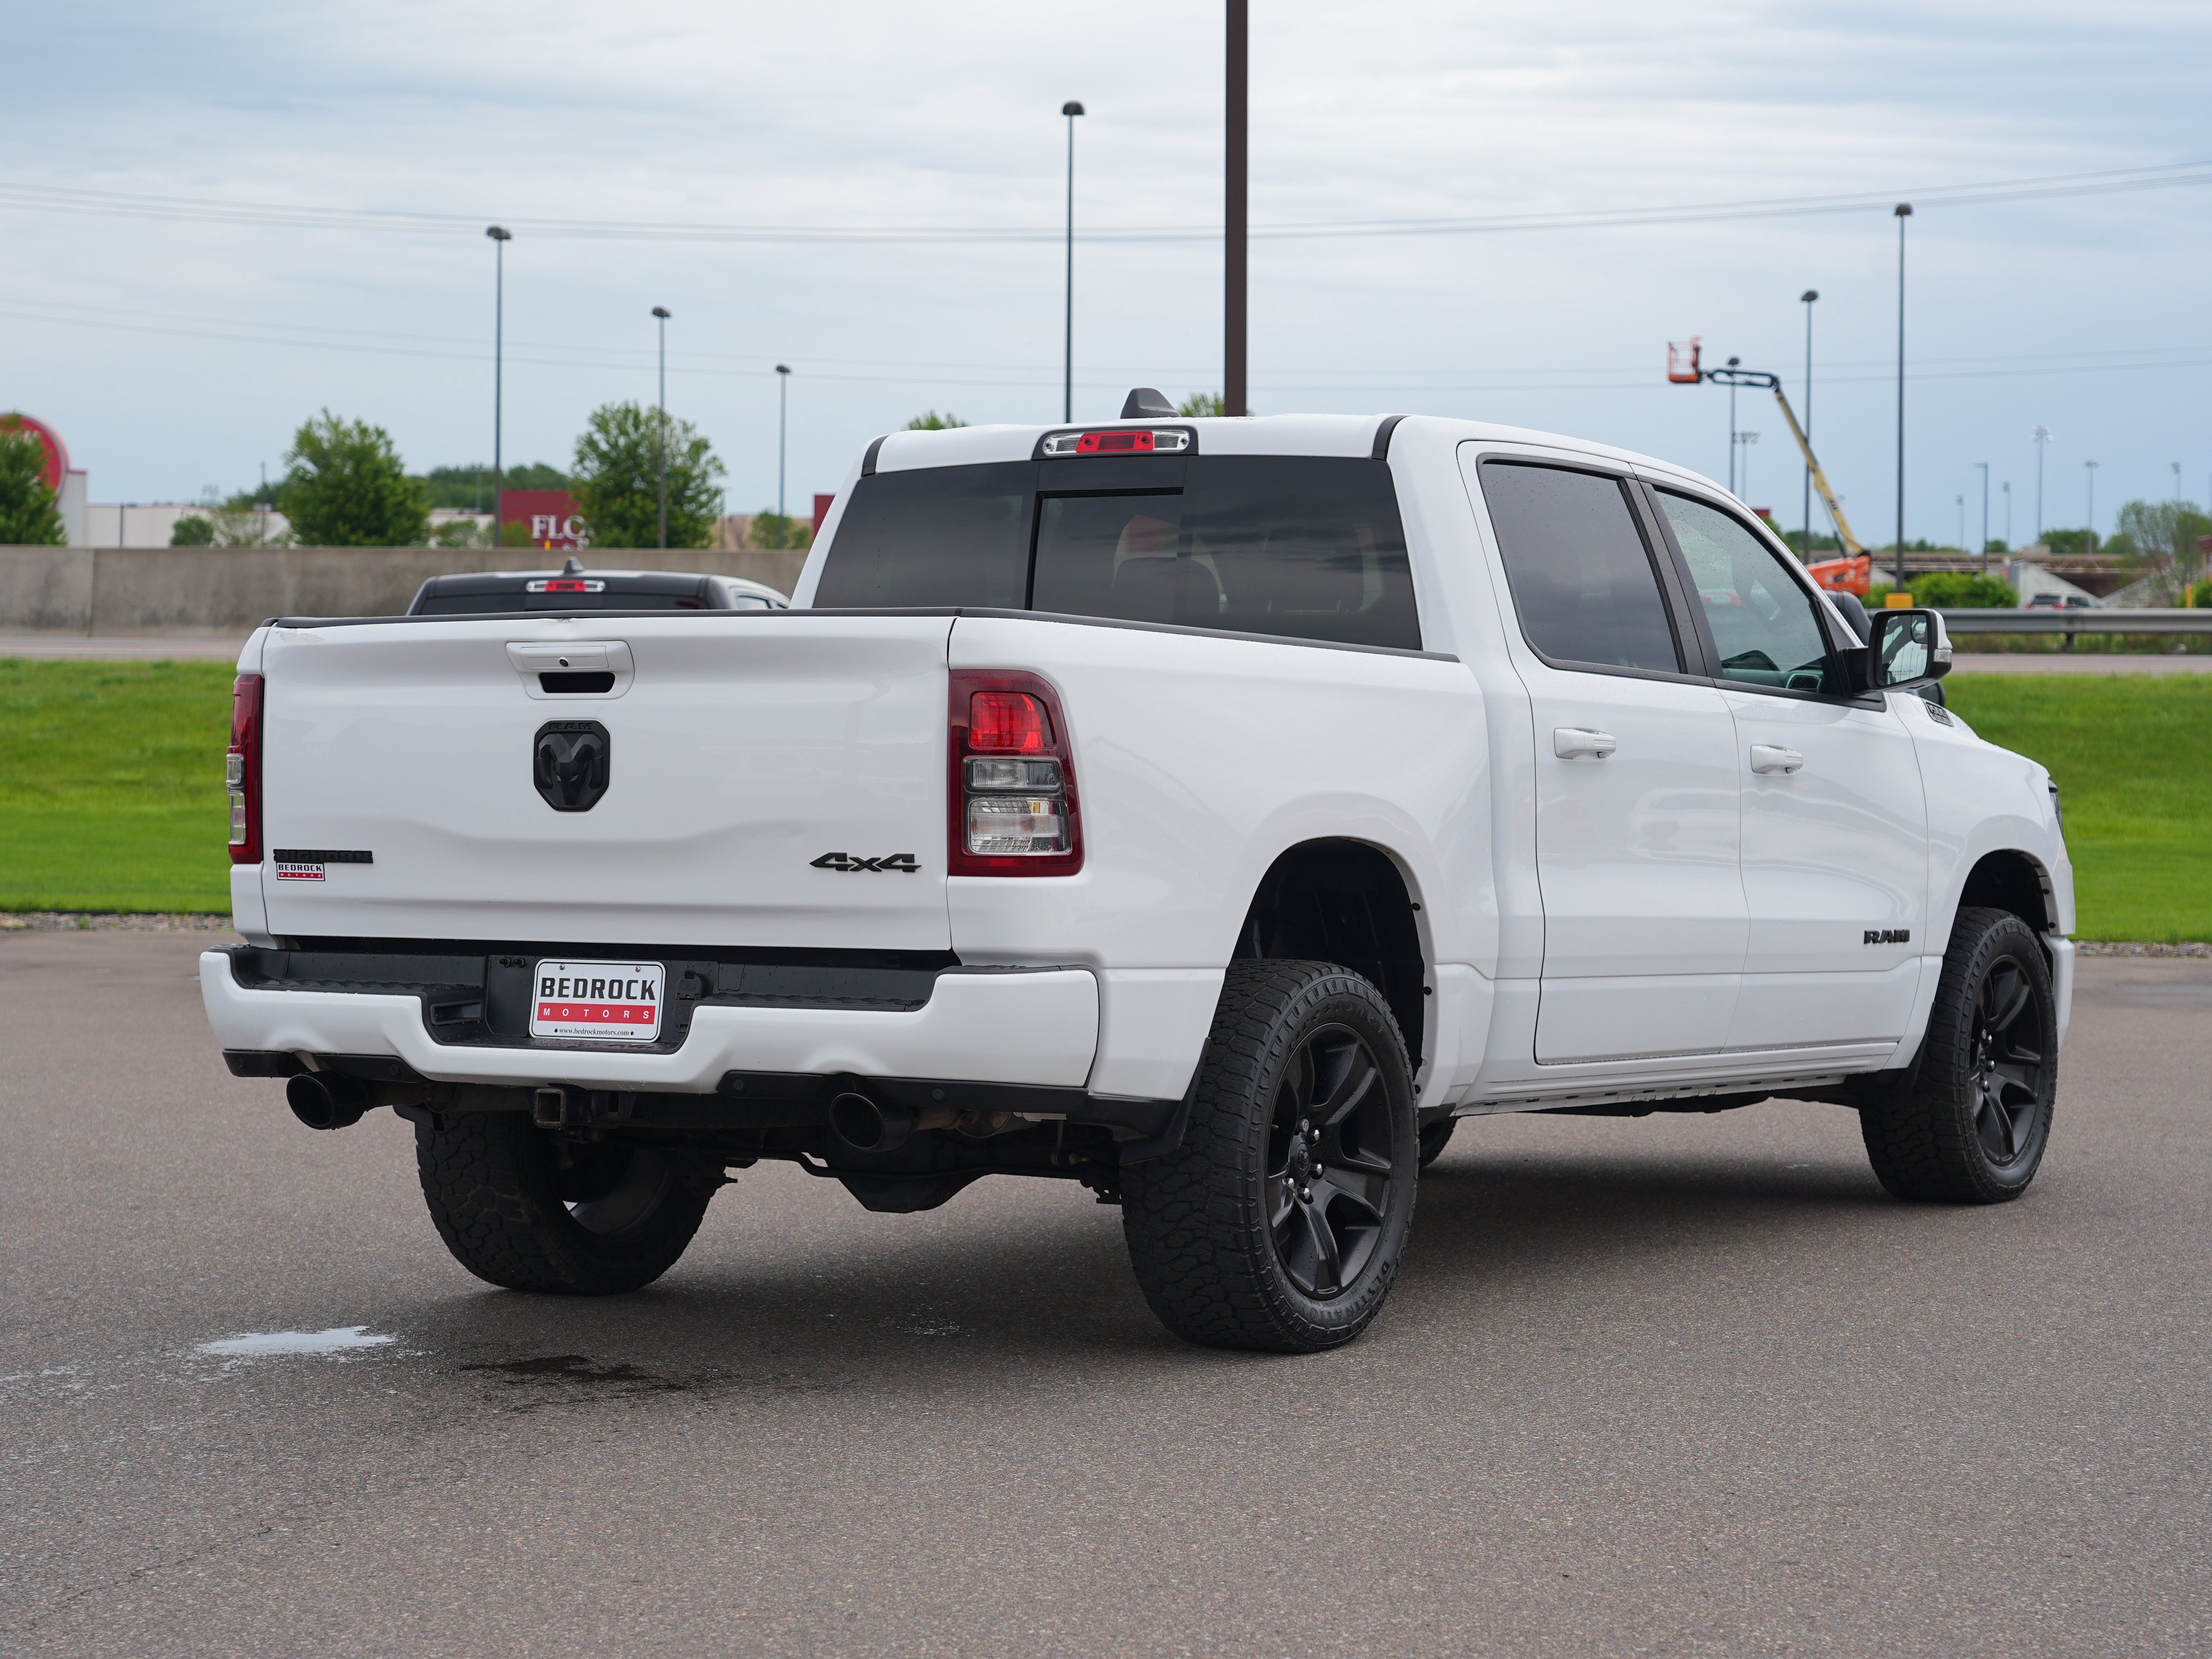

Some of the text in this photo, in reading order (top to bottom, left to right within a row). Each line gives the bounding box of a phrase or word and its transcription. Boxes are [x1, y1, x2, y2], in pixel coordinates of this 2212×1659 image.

[548, 722, 593, 730] RAM
[809, 852, 922, 873] 4x4
[1863, 929, 1910, 945] RAM
[540, 977, 656, 1000] BEDROCK
[543, 1008, 650, 1020] MOTORS
